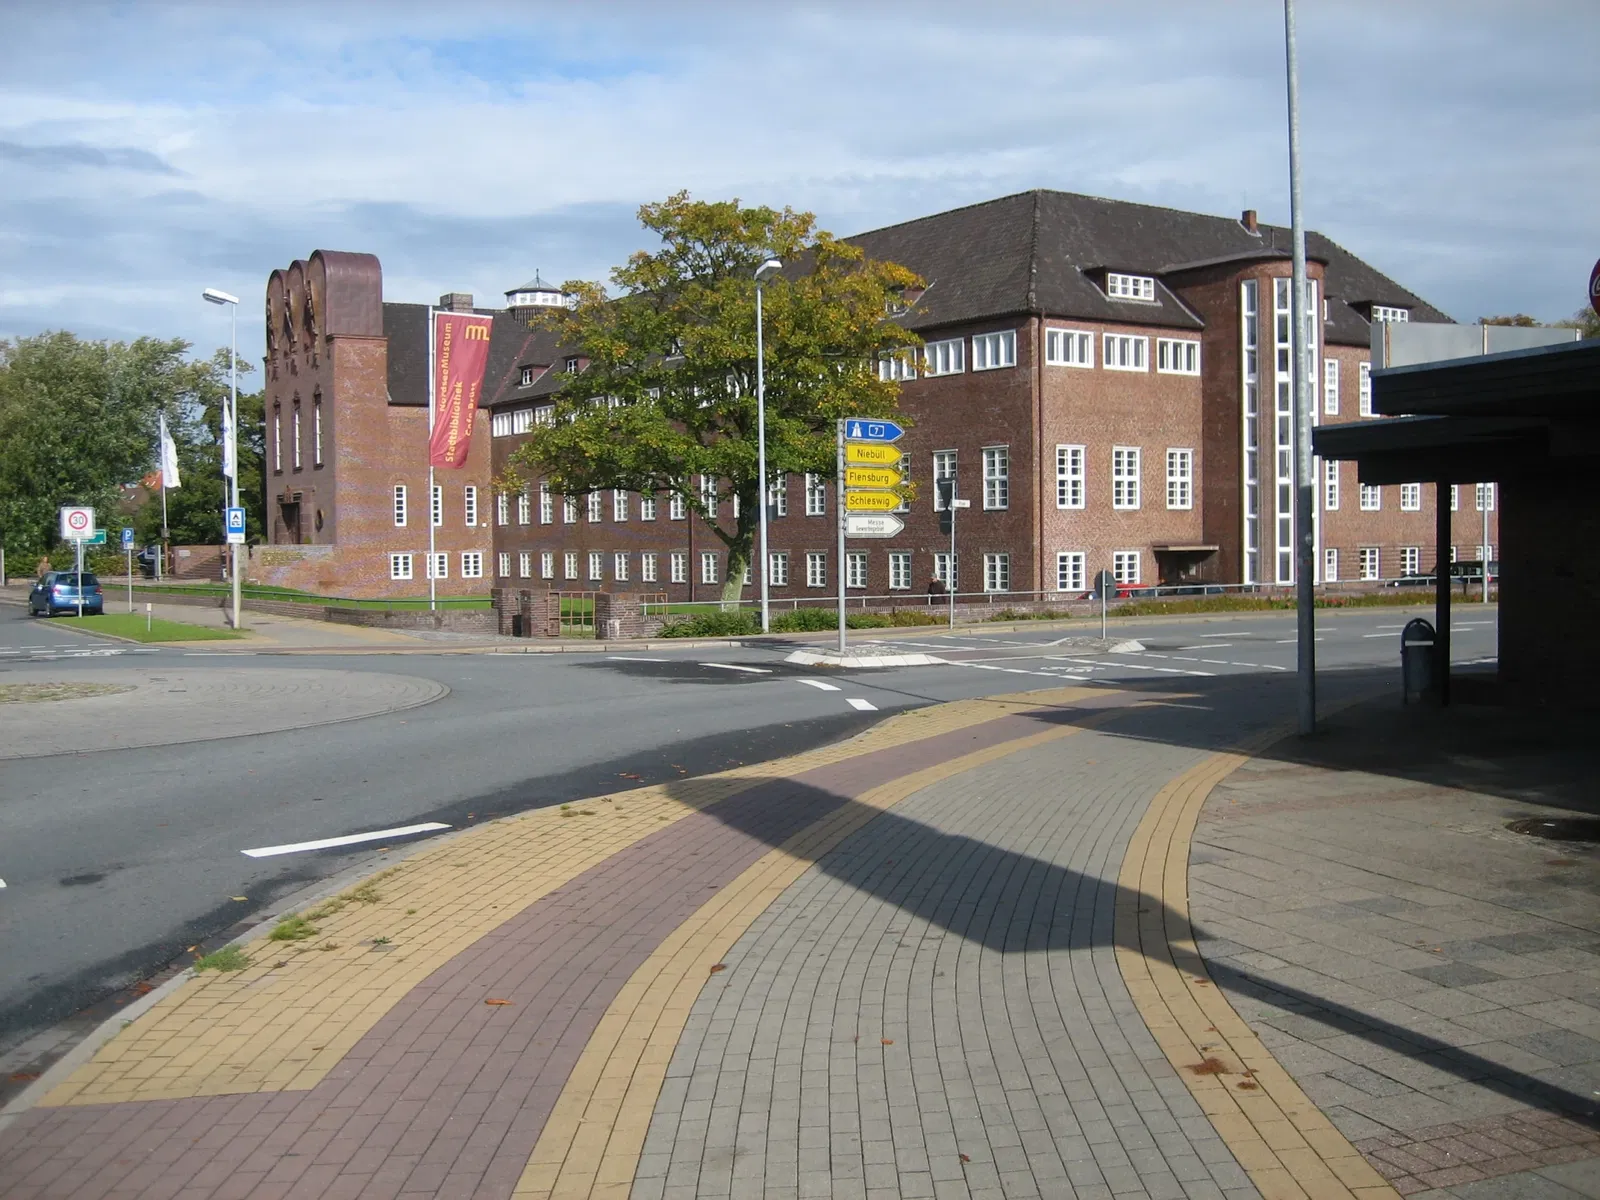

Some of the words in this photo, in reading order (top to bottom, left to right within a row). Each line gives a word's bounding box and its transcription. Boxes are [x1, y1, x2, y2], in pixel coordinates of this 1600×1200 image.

[440, 323, 452, 411] NordseeMuseum
[445, 381, 463, 462] Stadtbibliothek
[874, 427, 879, 435] 7
[857, 449, 886, 459] Niebüll
[850, 472, 889, 485] Flensburg
[850, 496, 890, 507] Schleswig
[73, 516, 84, 525] 30
[125, 529, 132, 540] P
